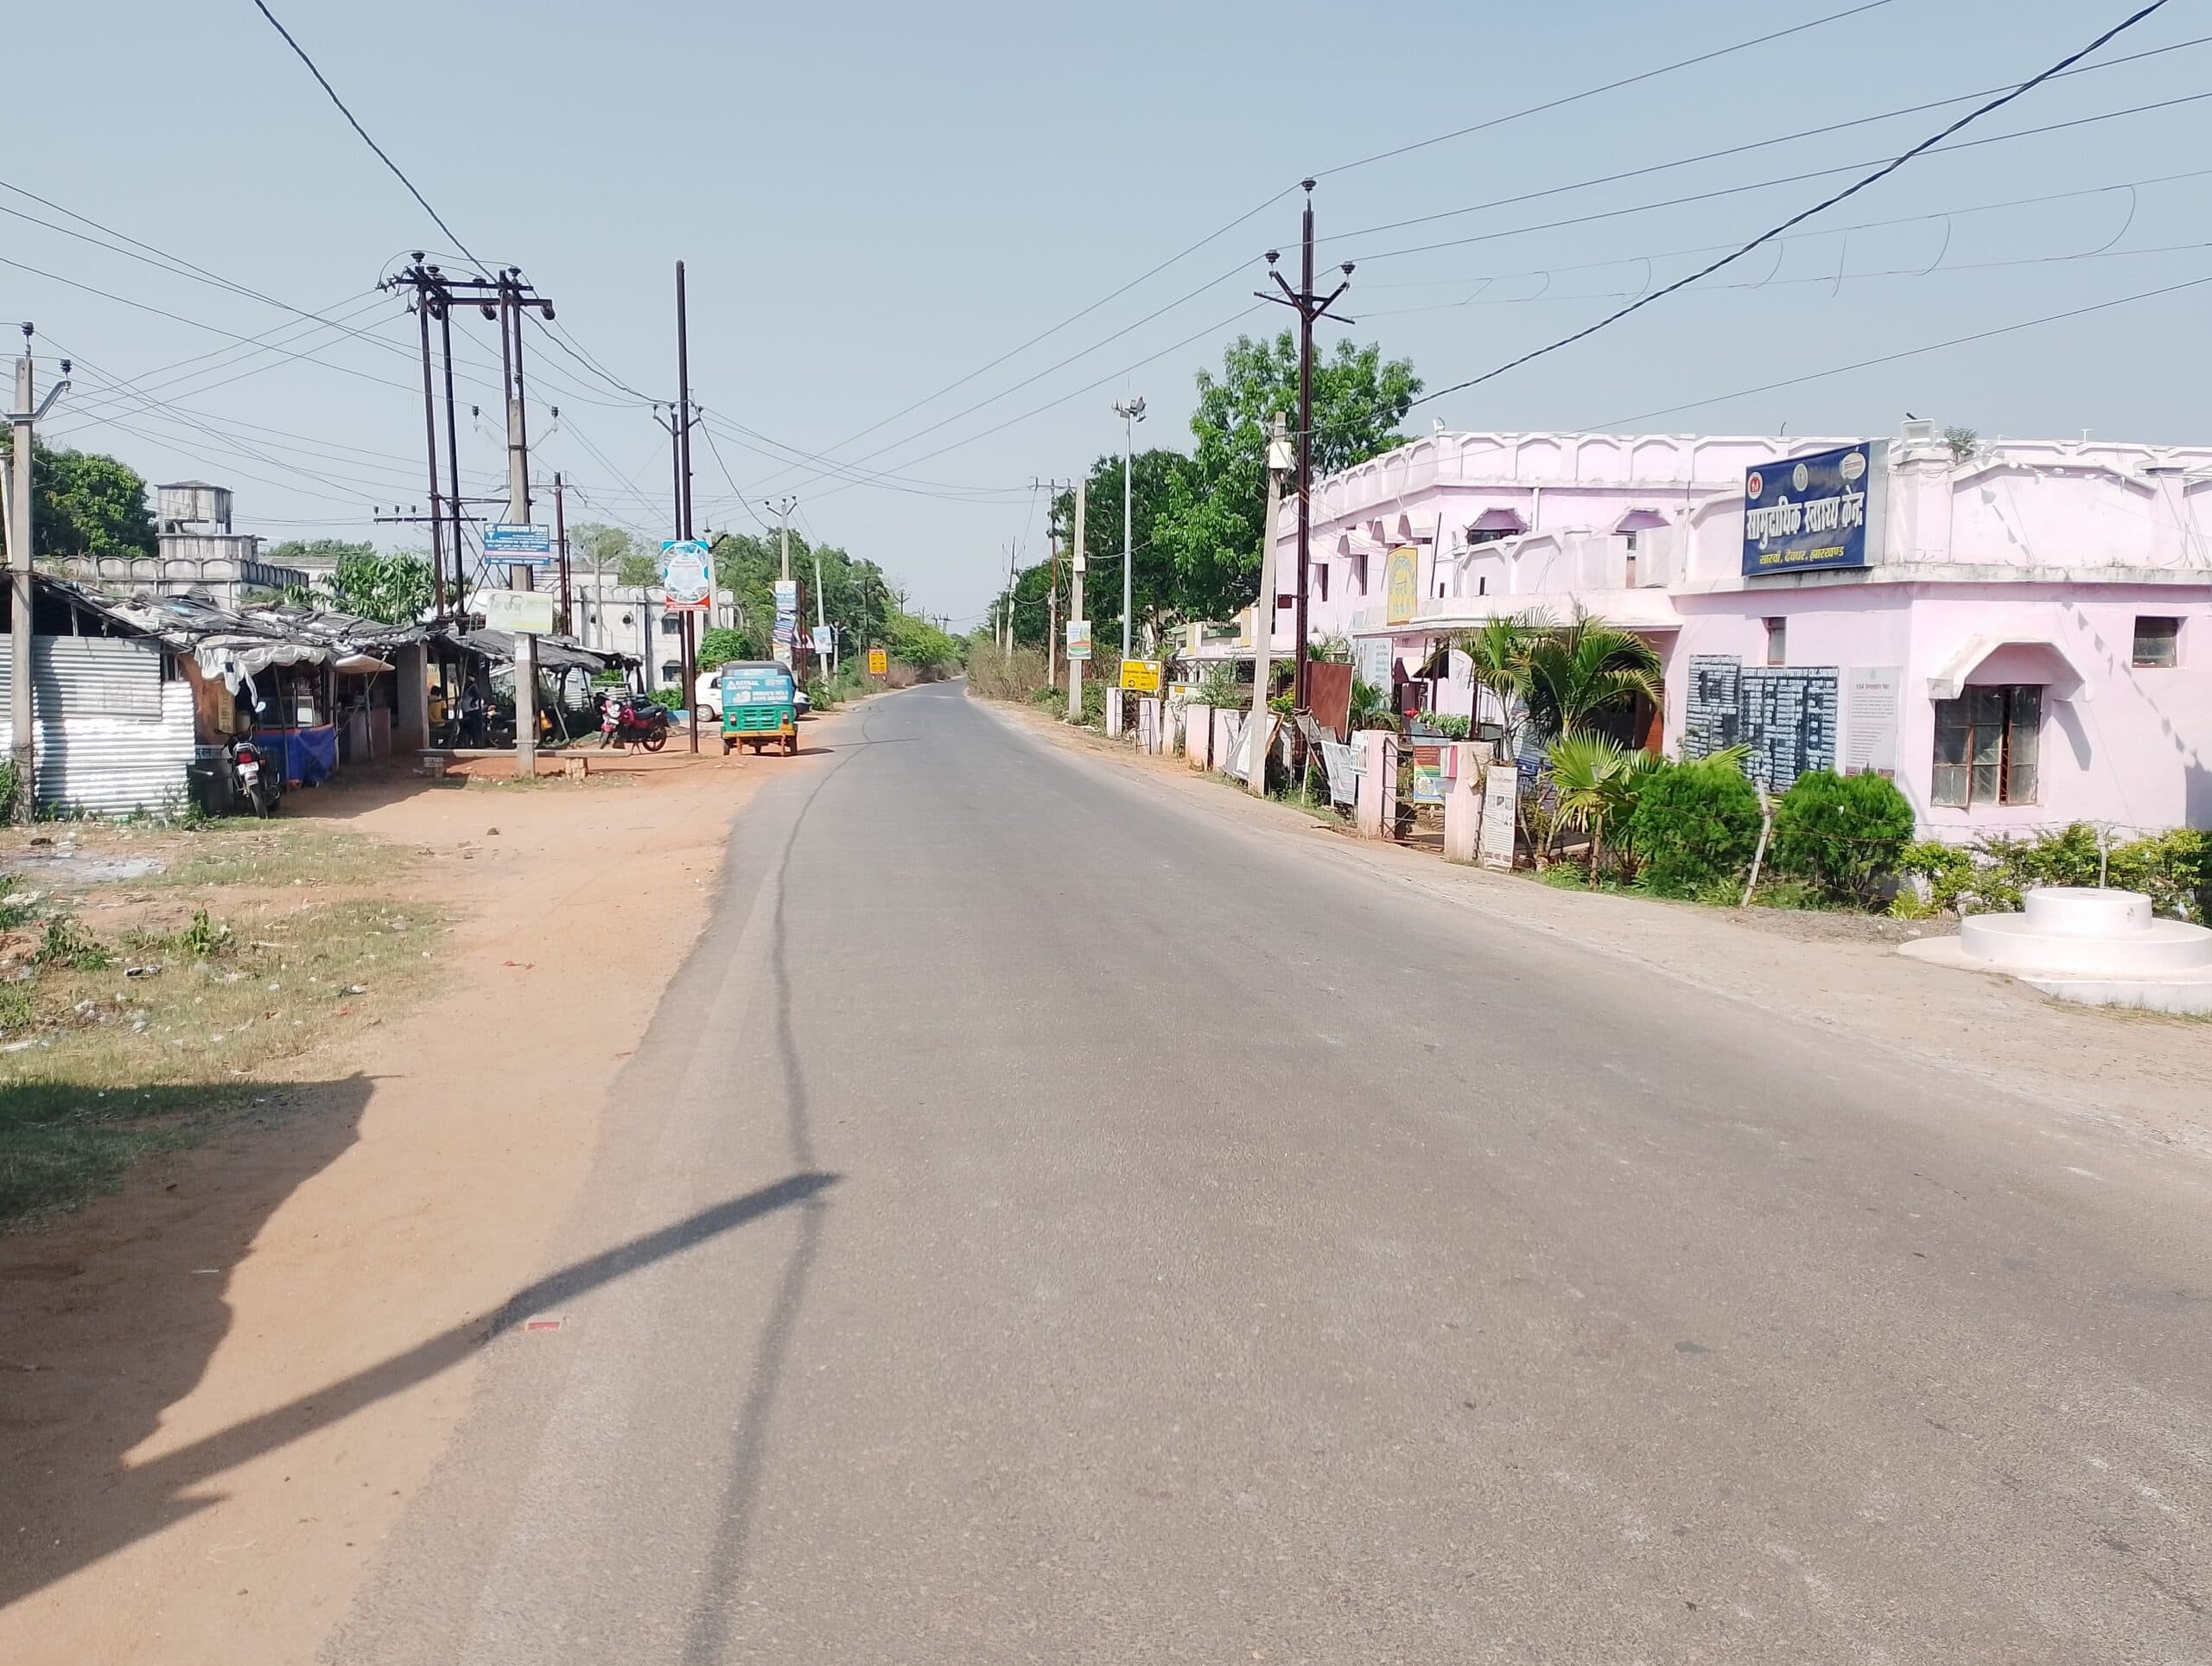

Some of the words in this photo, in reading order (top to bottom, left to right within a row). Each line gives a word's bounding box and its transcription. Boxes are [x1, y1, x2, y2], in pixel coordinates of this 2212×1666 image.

[1747, 495, 1802, 550] सामुदायिक
[1804, 496, 1840, 533] स्वास्थ्य
[1841, 485, 1865, 528] केन्द्र
[1810, 546, 1845, 563] झारखण्ड
